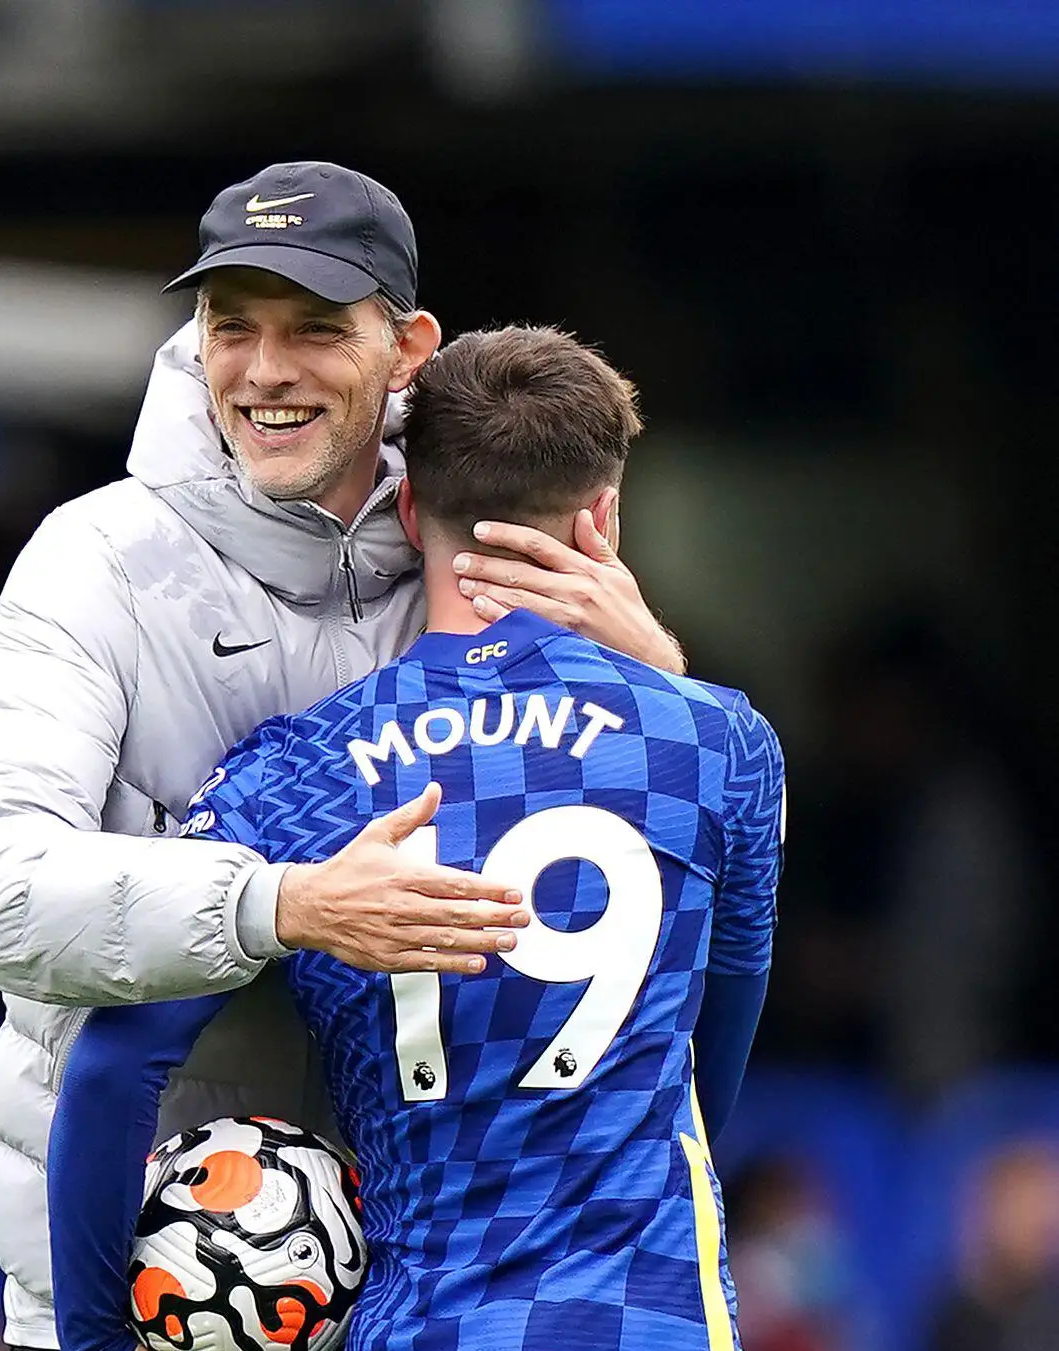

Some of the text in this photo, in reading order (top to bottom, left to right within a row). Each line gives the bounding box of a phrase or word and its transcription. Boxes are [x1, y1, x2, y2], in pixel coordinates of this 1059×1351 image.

[465, 640, 508, 665] CFC
[347, 692, 625, 786] MOUNT
[391, 804, 663, 1101] 19
